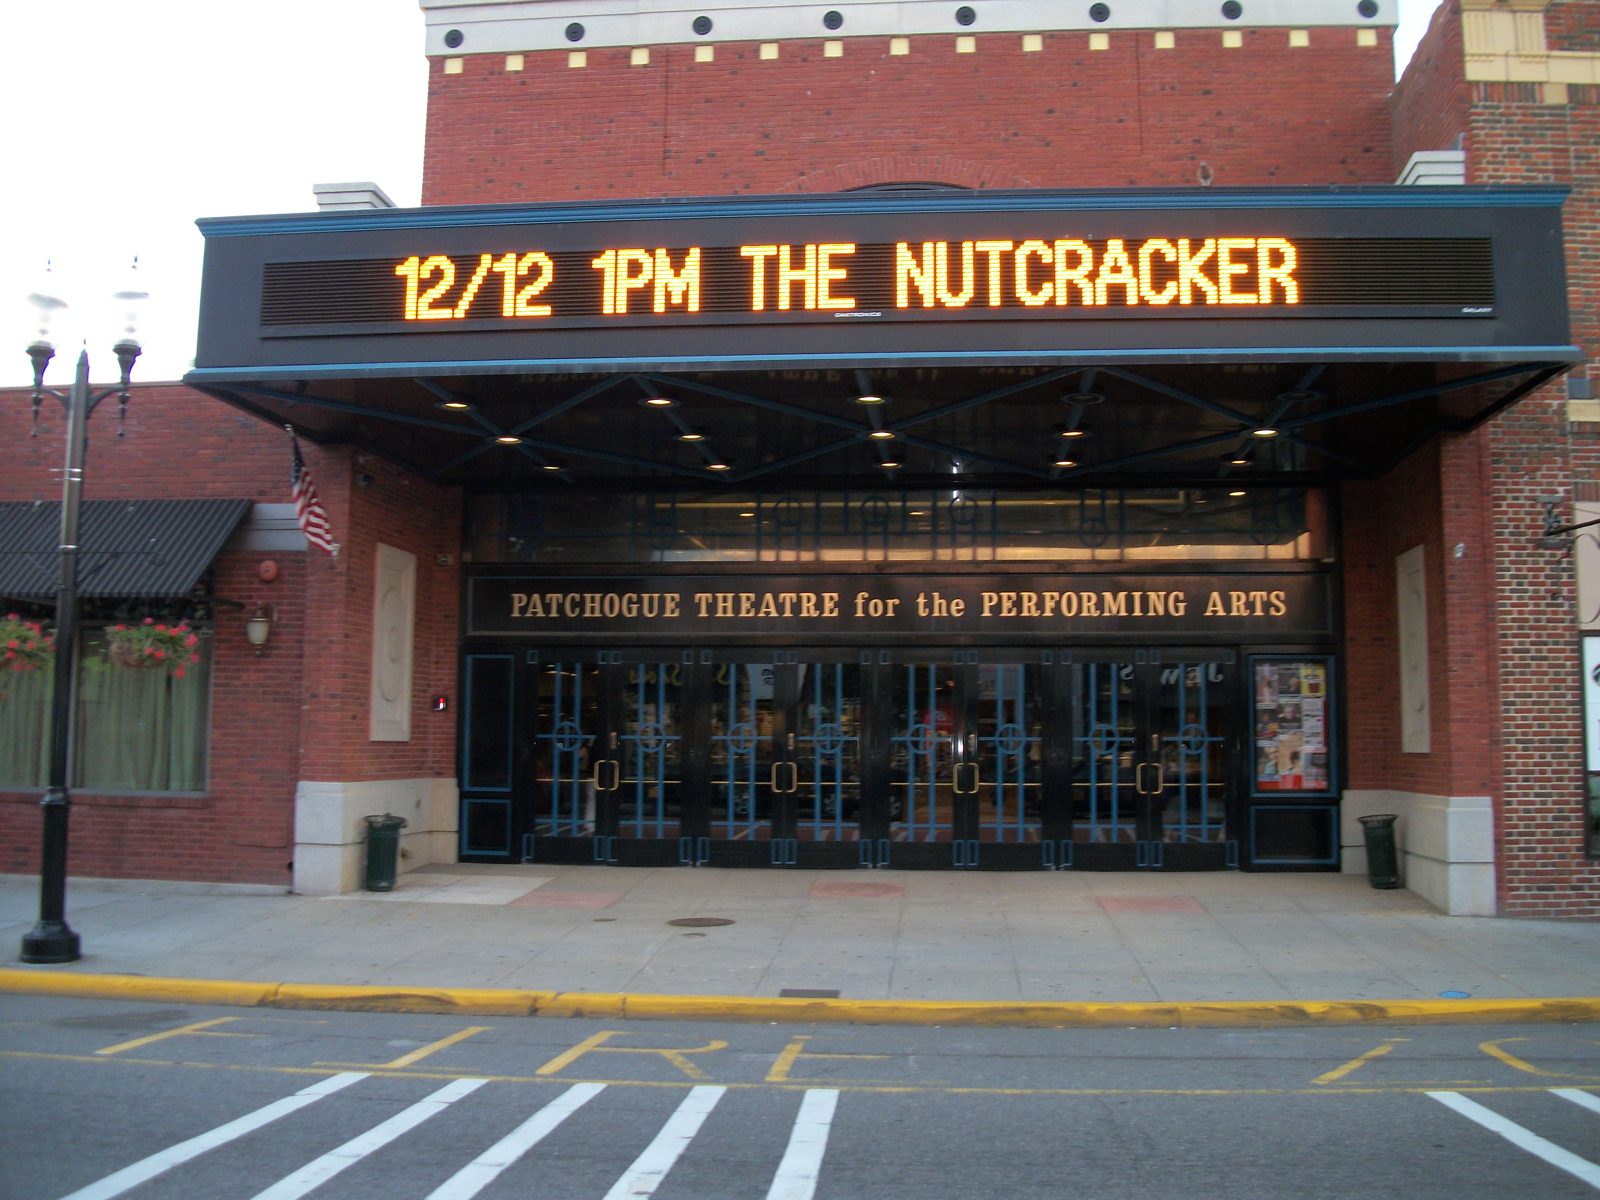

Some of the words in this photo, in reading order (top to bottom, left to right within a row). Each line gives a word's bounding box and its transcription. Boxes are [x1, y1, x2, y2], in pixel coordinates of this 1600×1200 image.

[394, 251, 553, 320] 12/12
[591, 246, 700, 315] 1PM
[740, 243, 857, 312] THE
[895, 237, 1300, 308] NUTCRACKER
[510, 592, 681, 618] PATCHOGUE
[694, 592, 840, 618] THEATRE
[854, 591, 901, 618] for
[916, 591, 965, 618] the
[980, 590, 1187, 618] PERFORMING
[1204, 590, 1287, 617] ARTS
